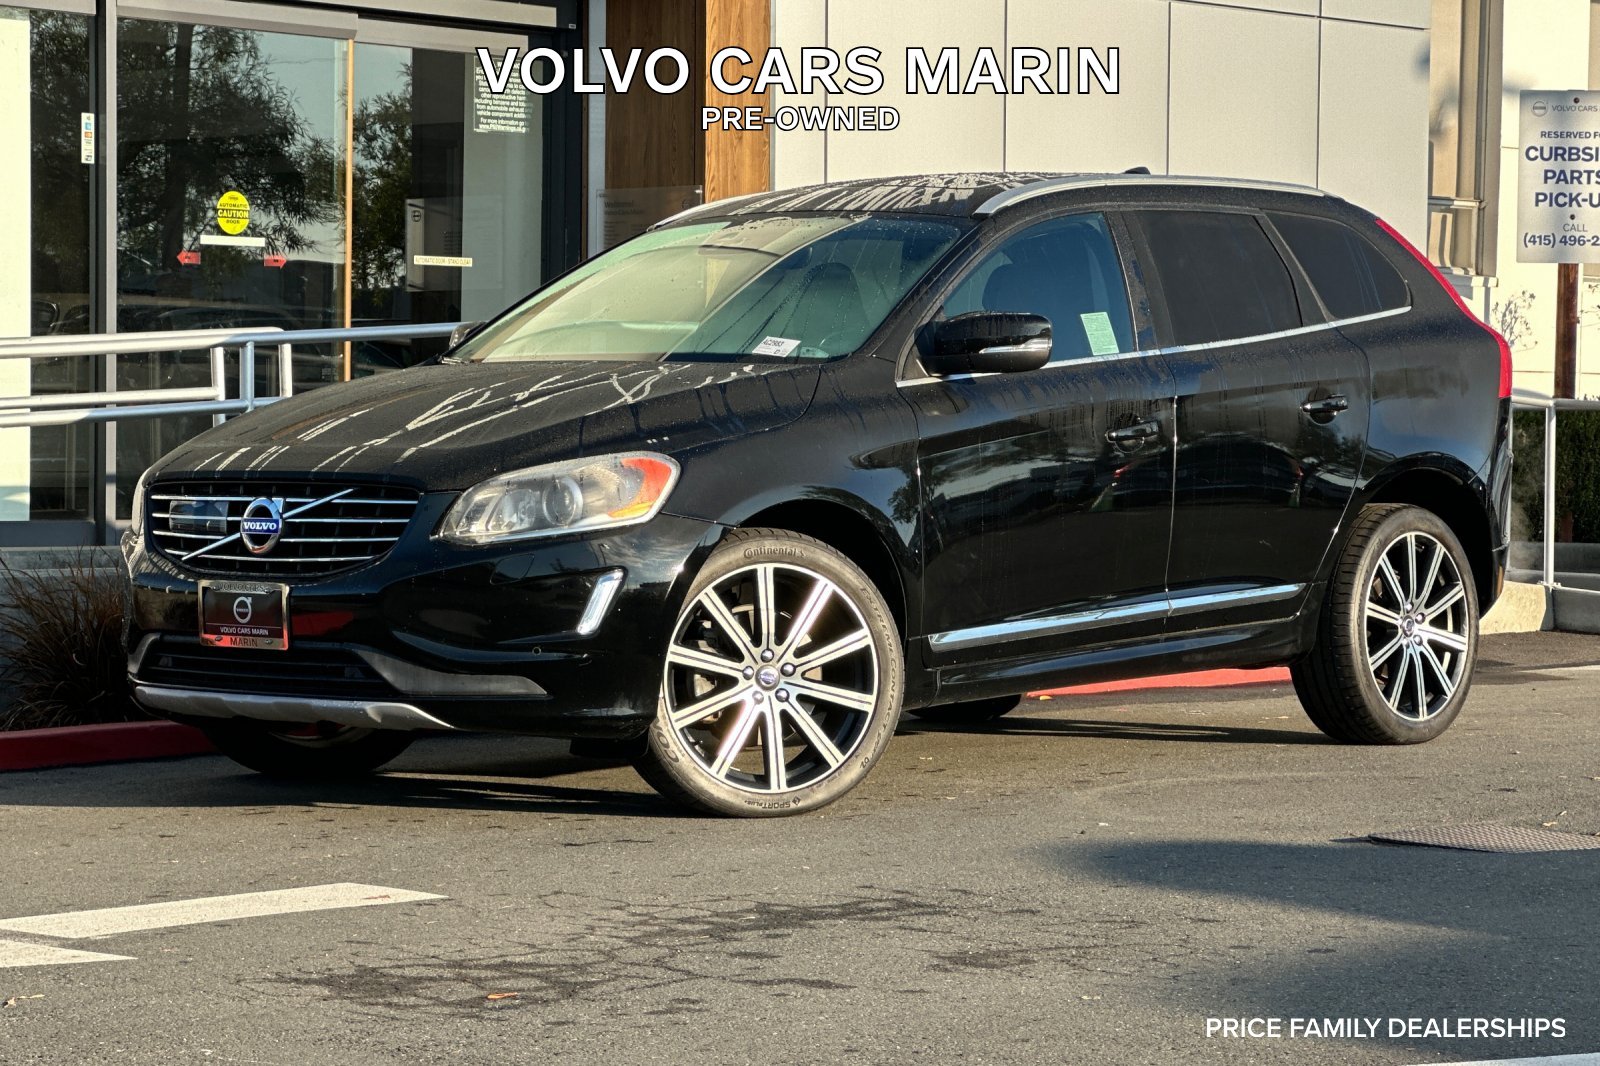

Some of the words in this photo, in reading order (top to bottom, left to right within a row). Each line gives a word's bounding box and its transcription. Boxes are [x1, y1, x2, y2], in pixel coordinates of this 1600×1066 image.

[1540, 130, 1592, 139] RESERVED
[1525, 145, 1599, 162] CURBSI
[1534, 192, 1600, 208] PICK-U
[217, 209, 249, 218] CAUTION
[1562, 223, 1588, 232] CALL
[1523, 232, 1556, 248] (415)
[1559, 235, 1600, 246] 496-2
[243, 521, 277, 530] VOLVO
[743, 546, 797, 559] Continental
[230, 637, 258, 647] MARIN
